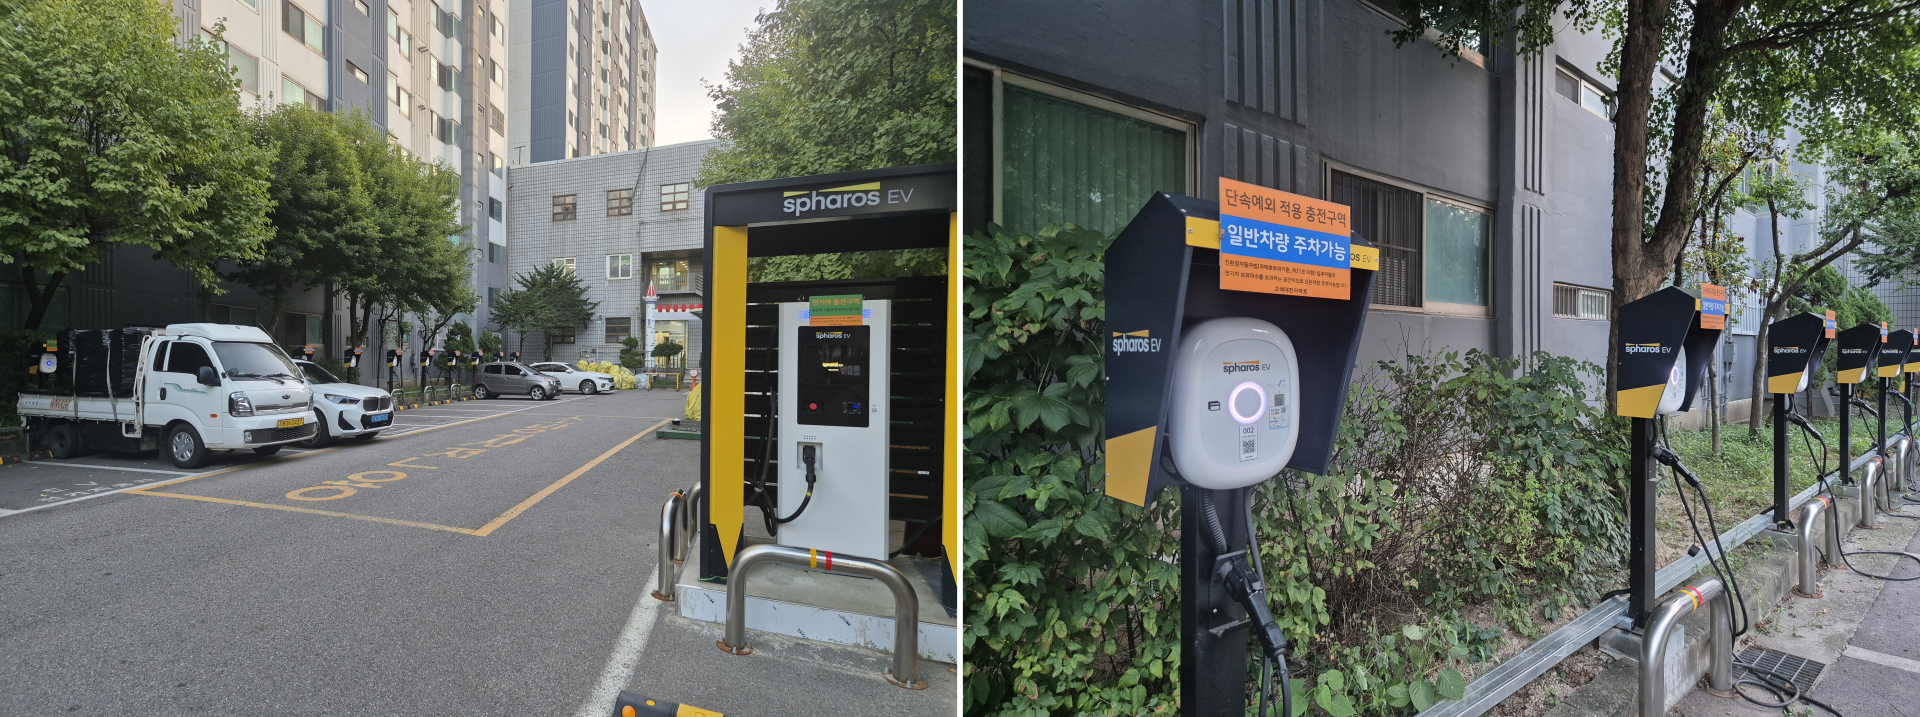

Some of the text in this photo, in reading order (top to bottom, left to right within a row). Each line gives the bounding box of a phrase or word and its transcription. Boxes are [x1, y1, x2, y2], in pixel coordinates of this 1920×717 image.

[783, 188, 914, 217] spharos EV
[1225, 188, 1347, 229] 단속예외 적용 충전구역
[1227, 224, 1347, 262] 일반차량 주차가능
[1362, 254, 1372, 263] EV
[812, 297, 860, 307] 전기차 충전구역
[816, 332, 843, 340] spharos
[1112, 333, 1162, 357] spharos EV
[1625, 344, 1672, 355] spharos EV
[1223, 362, 1271, 375] spharos EV
[1242, 426, 1255, 435] 002
